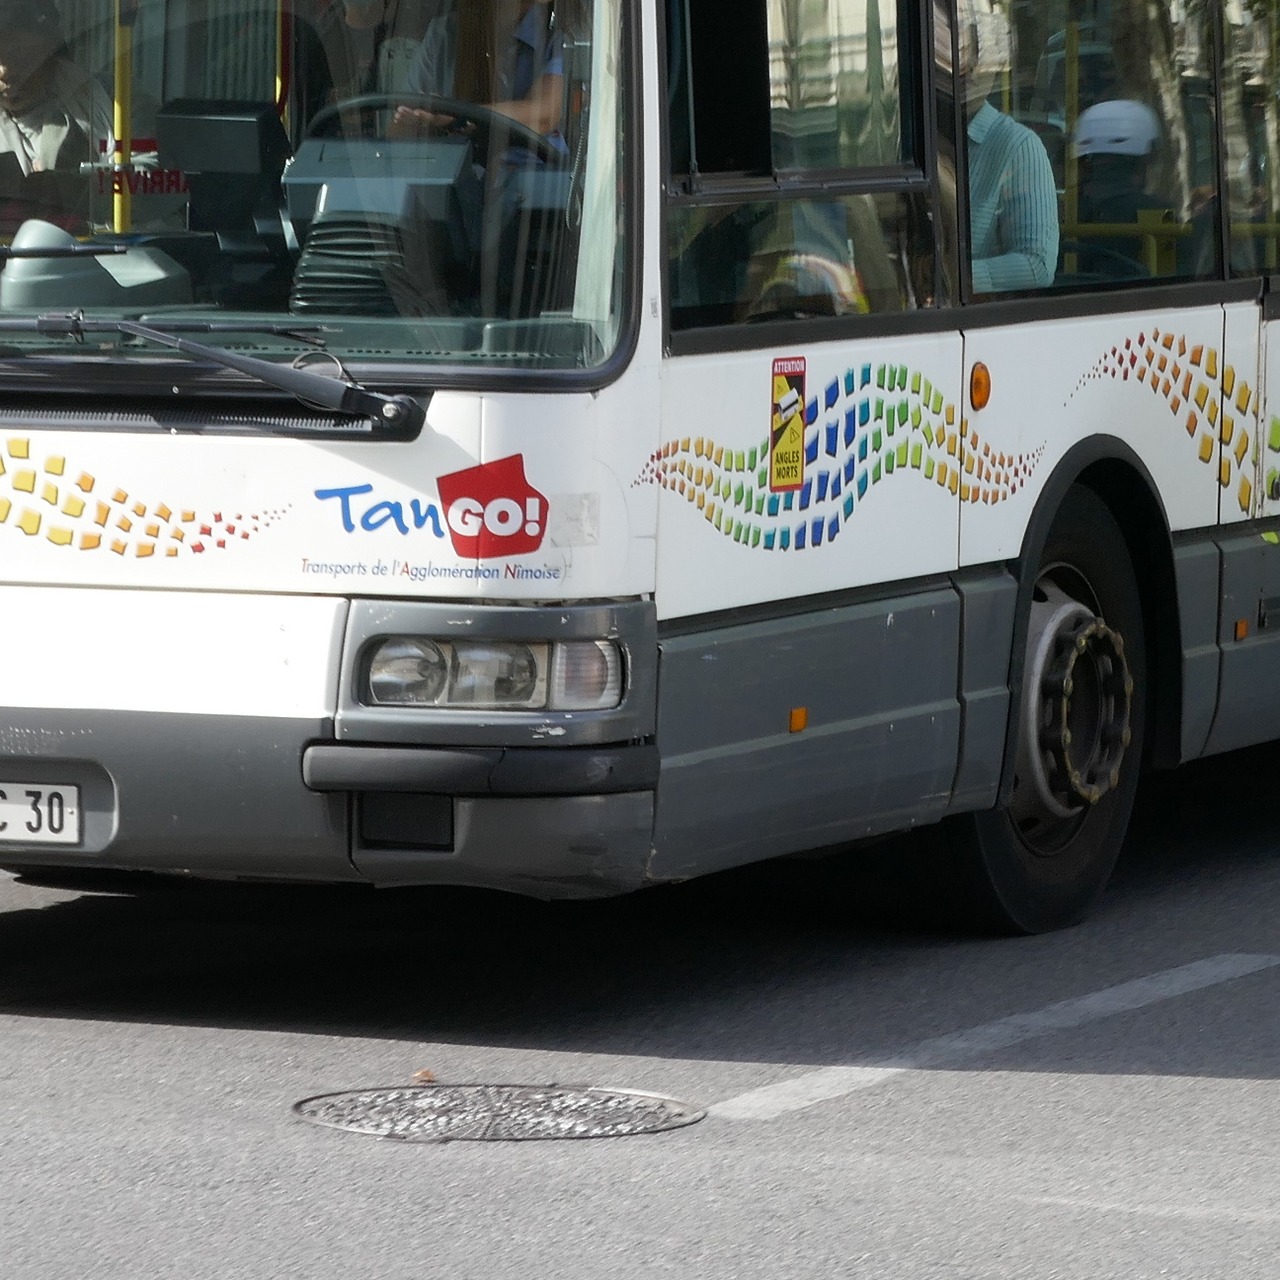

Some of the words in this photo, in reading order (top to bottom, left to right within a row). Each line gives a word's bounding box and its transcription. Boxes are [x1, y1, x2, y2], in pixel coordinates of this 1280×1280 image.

[774, 361, 805, 373] ATTENTION
[775, 450, 800, 465] ANGLES
[776, 466, 798, 478] MORTS
[302, 558, 367, 579] Transports
[372, 560, 388, 576] de
[392, 561, 500, 581] l'Agglomération
[504, 564, 560, 580] Nîmoise
[25, 790, 64, 834] 30
